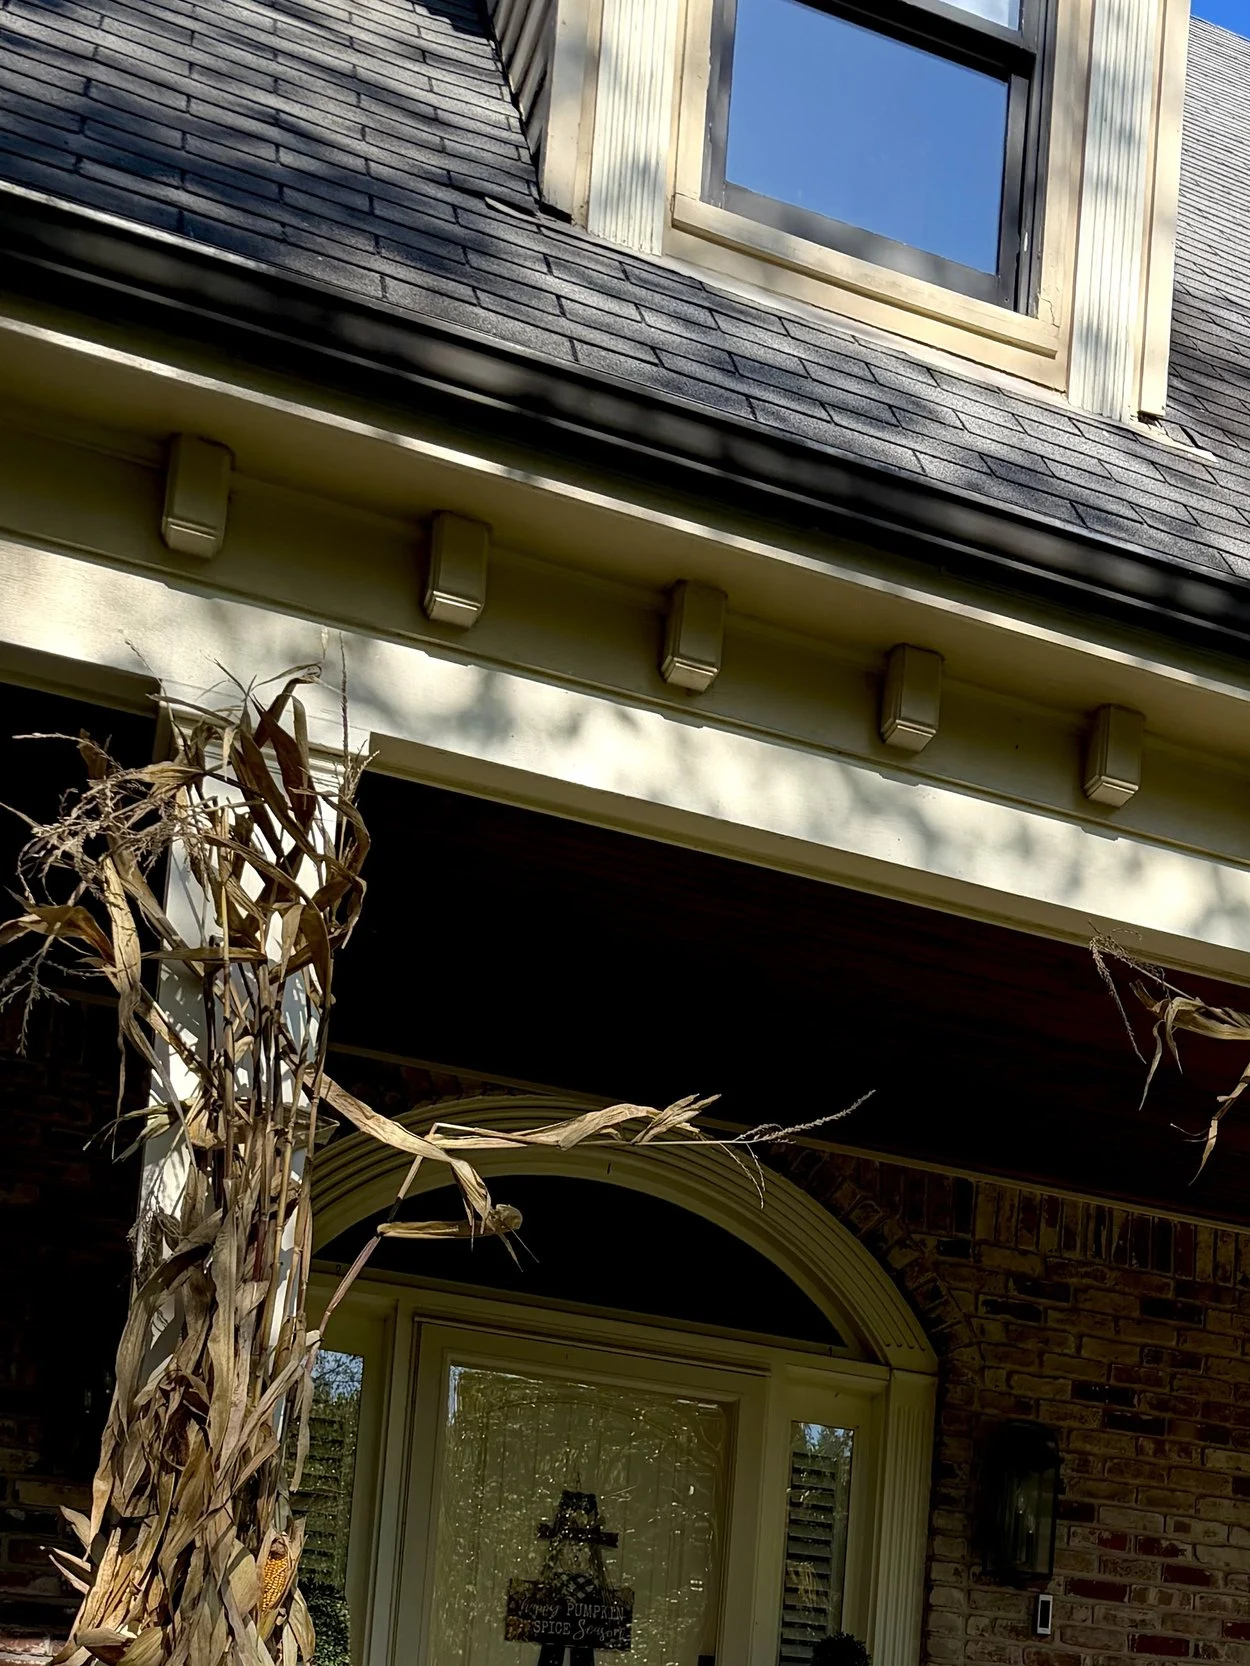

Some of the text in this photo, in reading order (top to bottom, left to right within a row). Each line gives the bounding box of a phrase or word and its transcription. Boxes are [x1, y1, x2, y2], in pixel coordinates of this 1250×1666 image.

[566, 1602, 625, 1621] PUMPKIN
[533, 1618, 625, 1641] SPICE Season
